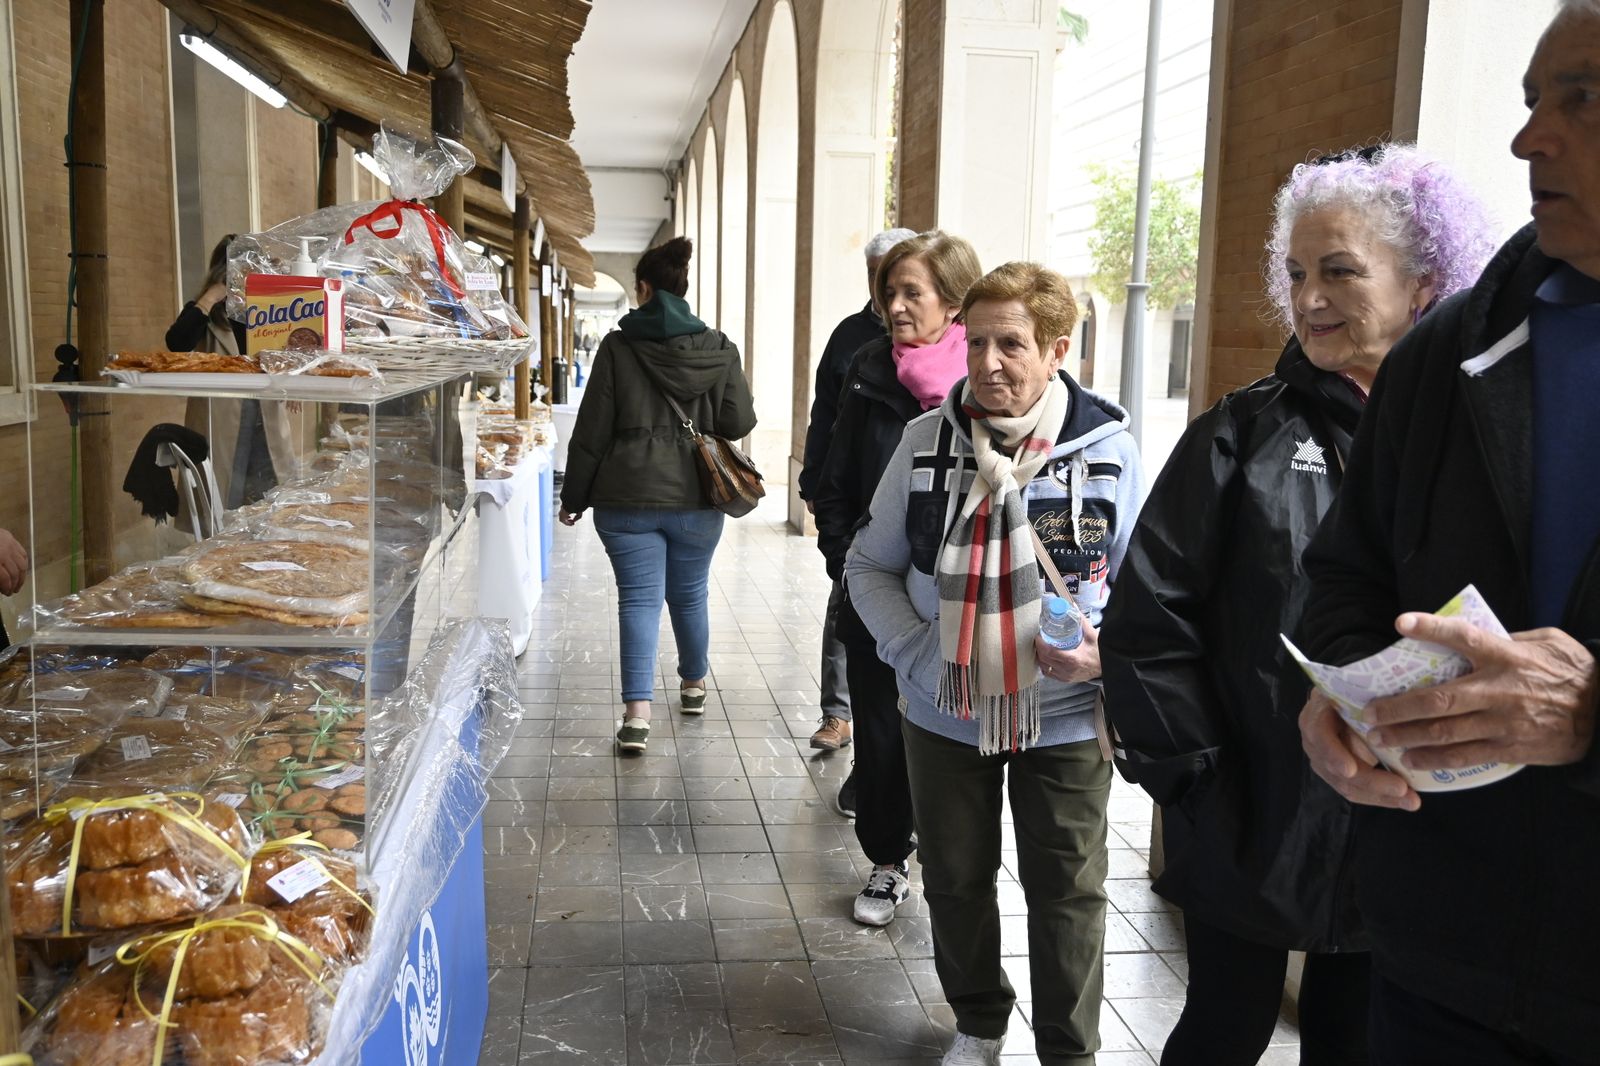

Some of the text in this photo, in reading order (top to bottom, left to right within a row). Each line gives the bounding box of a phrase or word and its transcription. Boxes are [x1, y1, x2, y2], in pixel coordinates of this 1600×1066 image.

[246, 298, 324, 329] ColaCao
[1291, 460, 1327, 475] luanvi
[1078, 529, 1103, 543] 958
[1457, 761, 1498, 777] HUELVA
